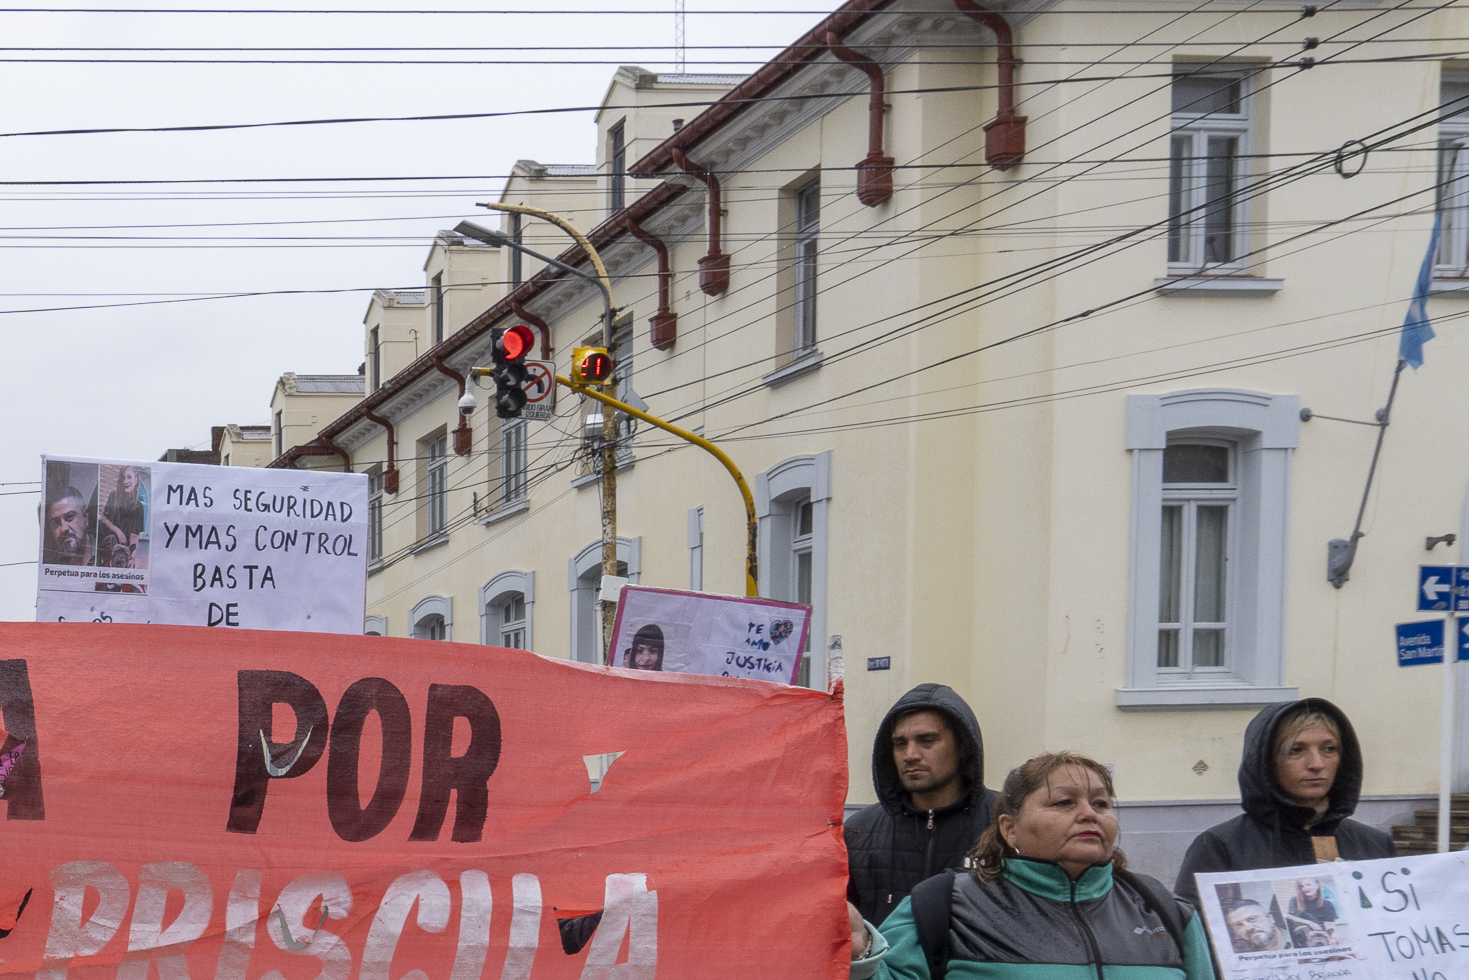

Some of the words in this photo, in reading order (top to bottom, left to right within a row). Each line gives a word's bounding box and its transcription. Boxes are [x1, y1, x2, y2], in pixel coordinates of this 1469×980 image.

[166, 484, 214, 508] MAS
[232, 488, 353, 523] SEGURIDAD
[254, 524, 359, 557] CONTROL
[44, 567, 79, 578] Perpetua
[80, 570, 98, 579] para
[99, 570, 110, 579] los
[111, 571, 145, 581] asesinos
[192, 562, 276, 592] BASTA
[207, 602, 240, 627] DE
[1399, 633, 1431, 647] Avenida
[1399, 648, 1418, 660] San
[225, 668, 503, 844] POR
[1238, 953, 1277, 962] Perpetua
[1278, 951, 1298, 959] para
[1313, 946, 1353, 955] asesinos
[1367, 923, 1469, 963] TOMAS
